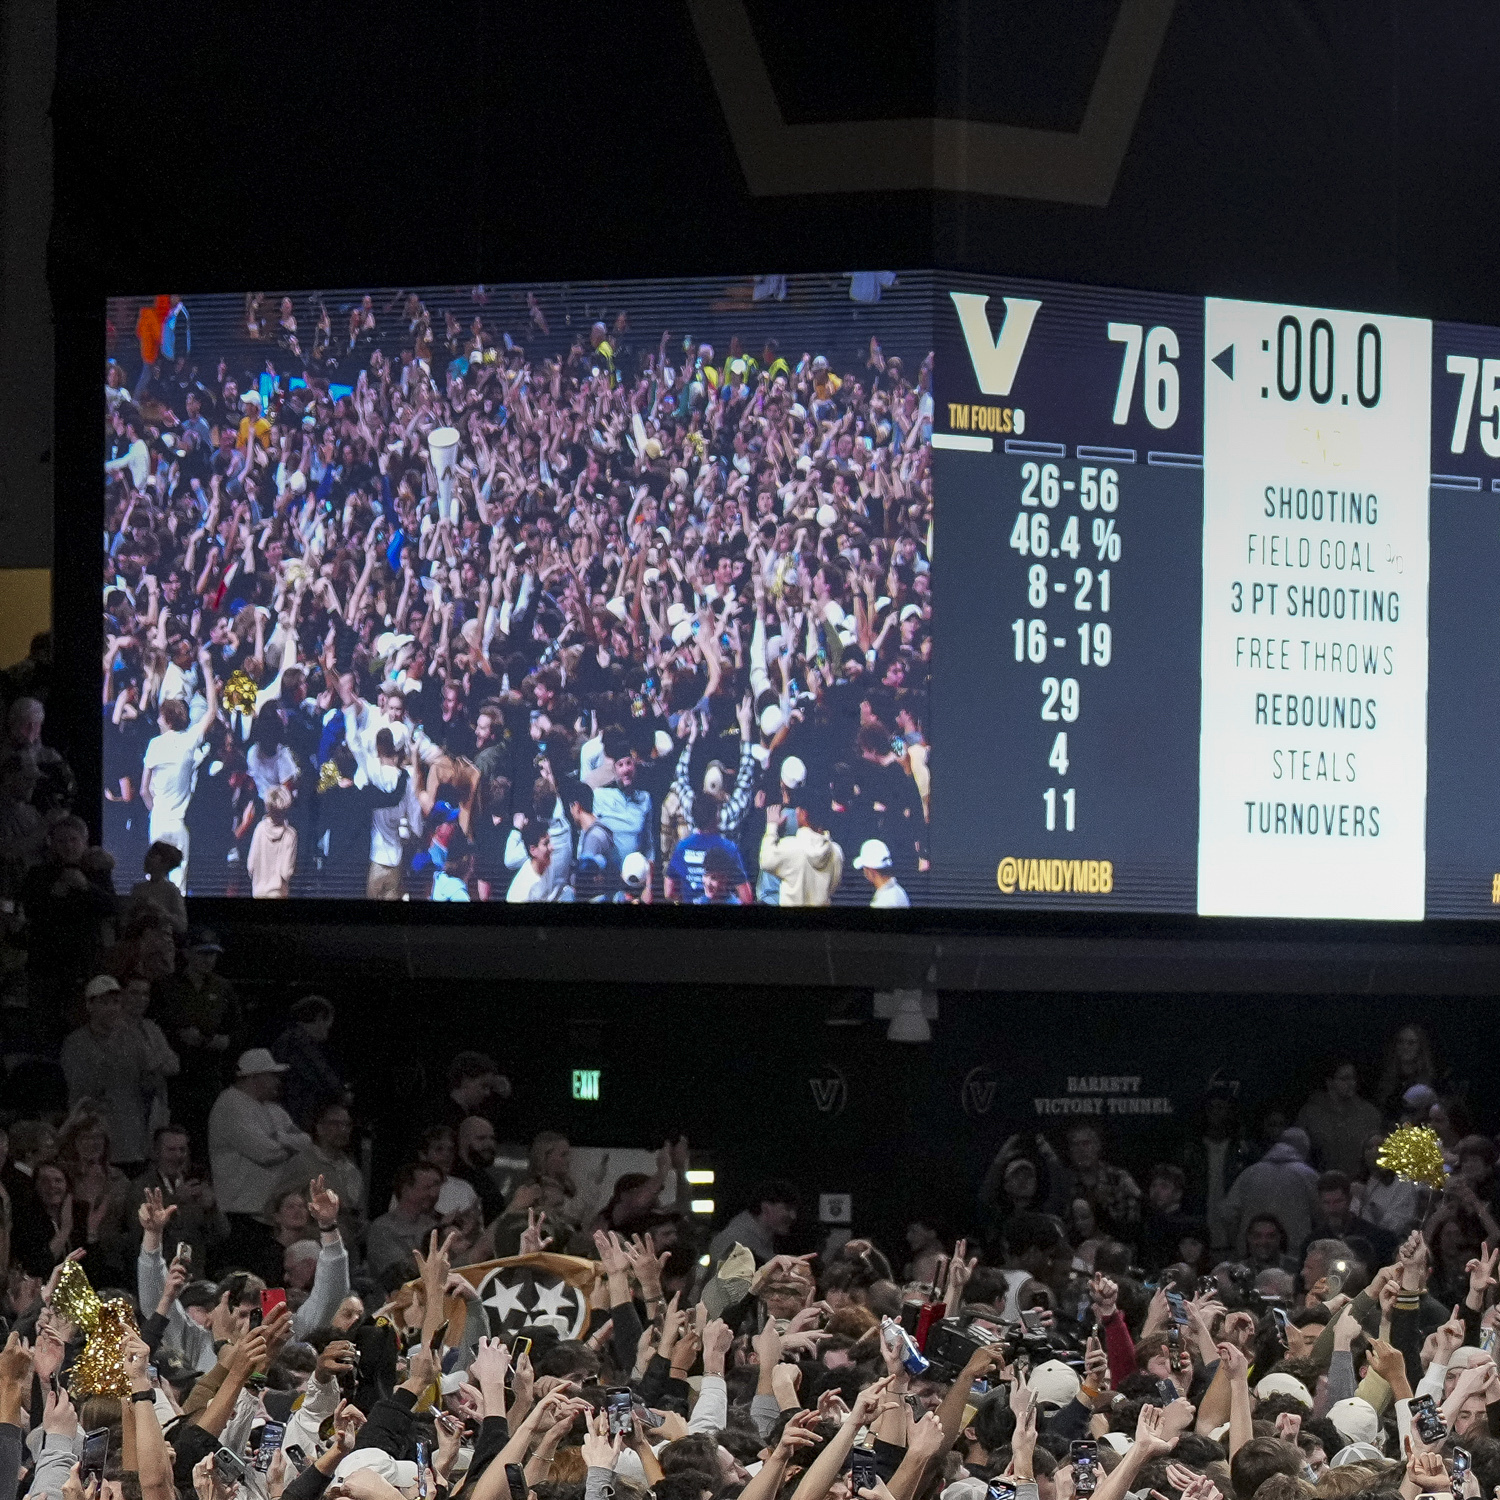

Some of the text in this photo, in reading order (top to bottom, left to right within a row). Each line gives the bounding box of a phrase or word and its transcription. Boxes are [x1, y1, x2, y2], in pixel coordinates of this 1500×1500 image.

[949, 292, 1042, 396] V
[1261, 314, 1383, 408] :00.0
[1107, 321, 1180, 430] 76
[948, 403, 1026, 435] TM FOULS 9
[1264, 485, 1378, 526] SHOOTING
[1009, 511, 1122, 563] 46.4 %
[1248, 533, 1310, 569] FIELD
[1320, 538, 1375, 573] GOAL
[1231, 581, 1399, 623] 3 PT SHOOTING
[1236, 636, 1393, 676] FREE THROWS
[1041, 676, 1080, 723] 29
[1255, 692, 1377, 730] REBOUNDS
[1048, 731, 1070, 776] 4
[1273, 749, 1356, 783] STEALS
[1042, 787, 1076, 832] 11
[1244, 801, 1380, 838] TURNOVERS
[997, 856, 1113, 894] @VANDYMBB
[573, 1069, 601, 1101] EXIT
[1034, 1097, 1173, 1115] VICTORY TUNNEL
